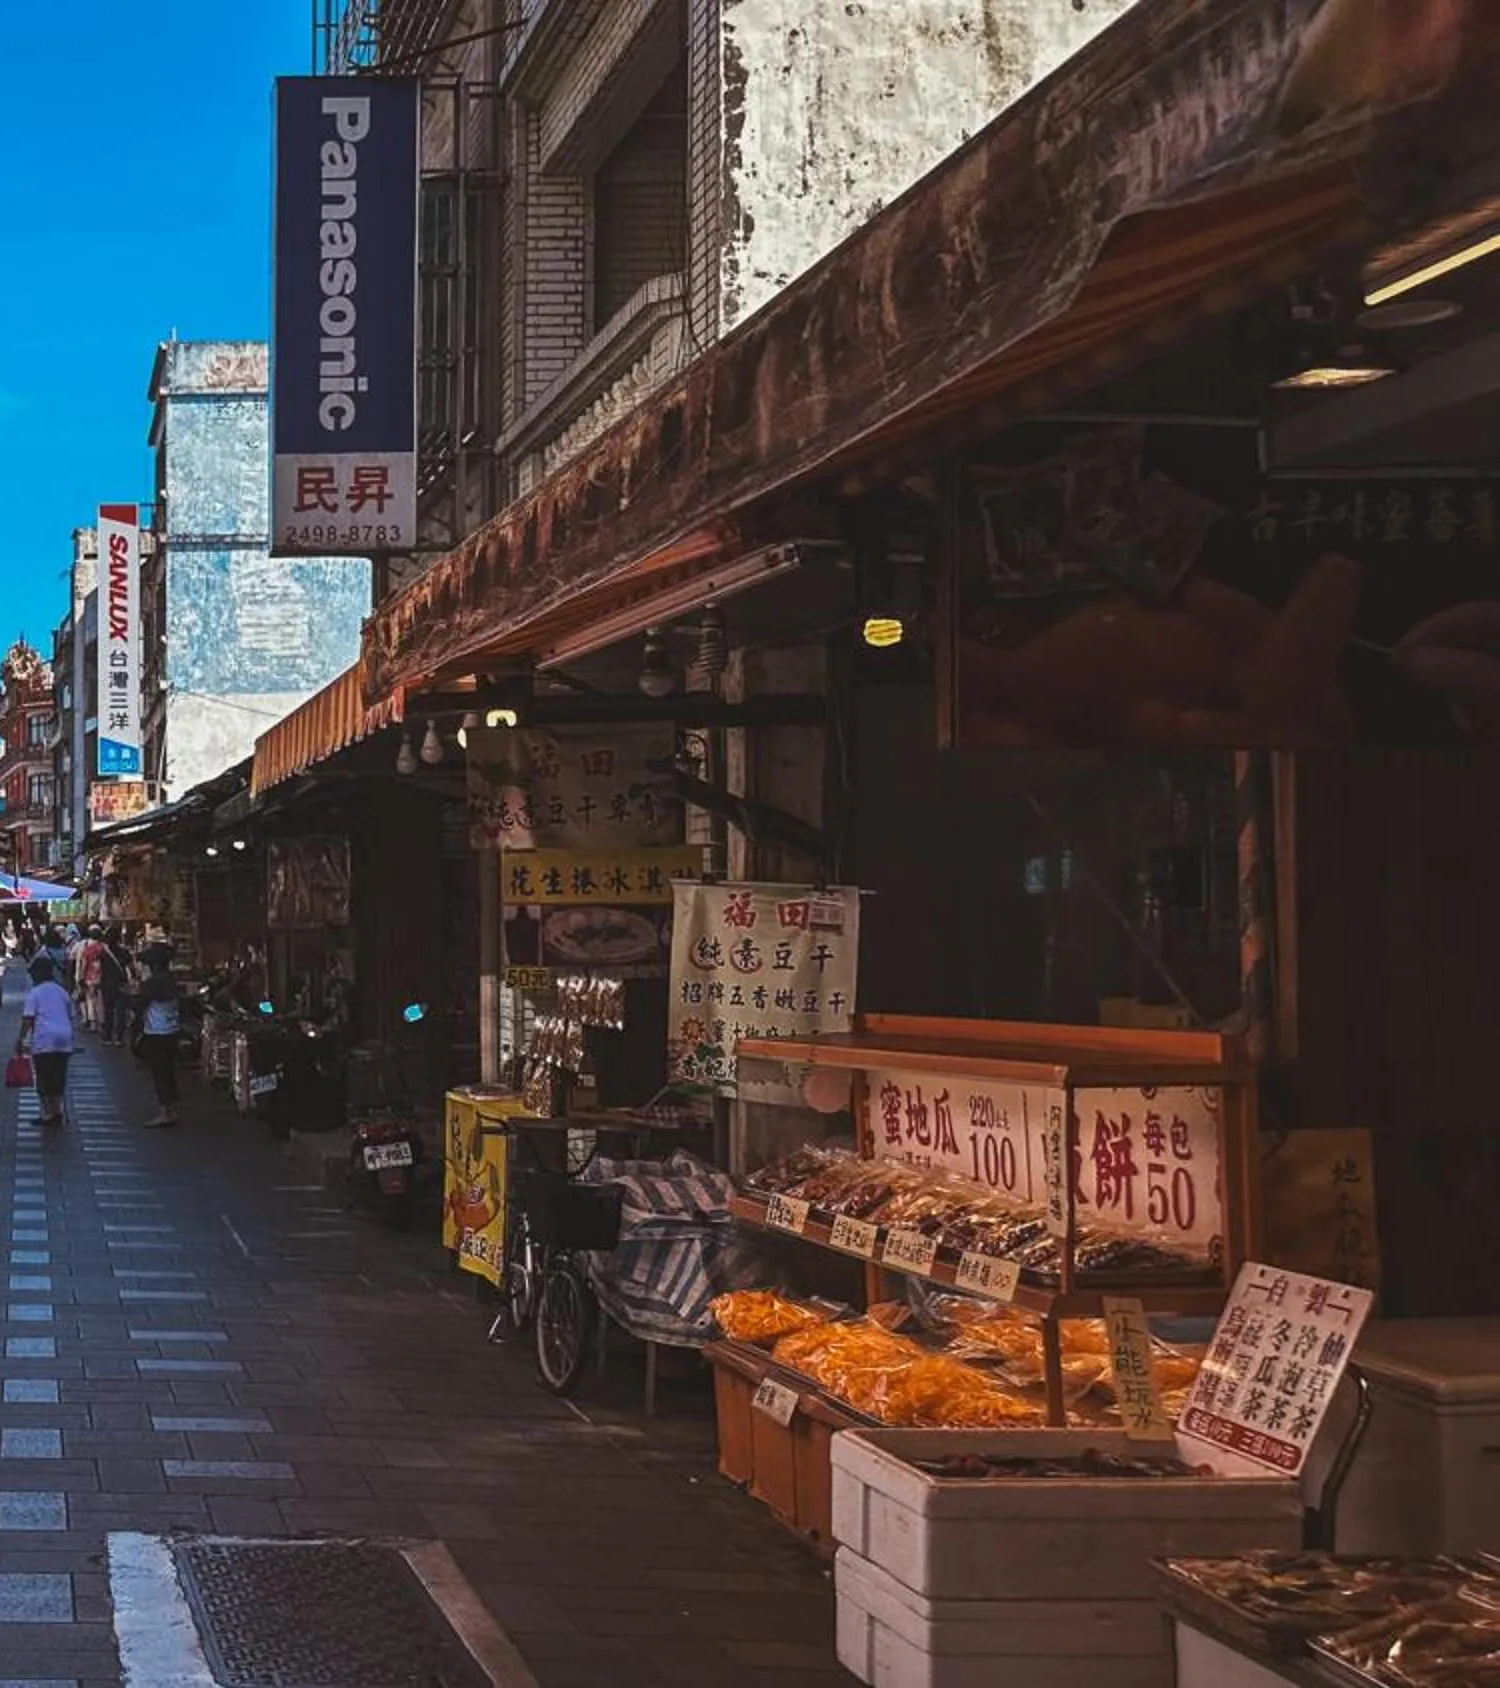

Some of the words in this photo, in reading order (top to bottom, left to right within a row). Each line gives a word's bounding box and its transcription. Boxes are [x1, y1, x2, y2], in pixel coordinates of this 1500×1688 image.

[318, 96, 371, 433] Panasonic
[292, 464, 395, 514] 民昇
[285, 523, 402, 545] 2498-8783
[109, 532, 129, 643] SANLUX
[109, 650, 130, 731] 台灣三洋
[723, 891, 811, 931] 福田
[696, 936, 836, 975] 純素豆干
[681, 979, 846, 1016] 招牌五香嫩豆干
[879, 1079, 961, 1156] 蜜地瓜
[1143, 1109, 1194, 1161] 每包
[968, 1132, 1017, 1192] 100
[1147, 1163, 1197, 1232] 50
[1241, 1317, 1294, 1422] 冬瓜茶
